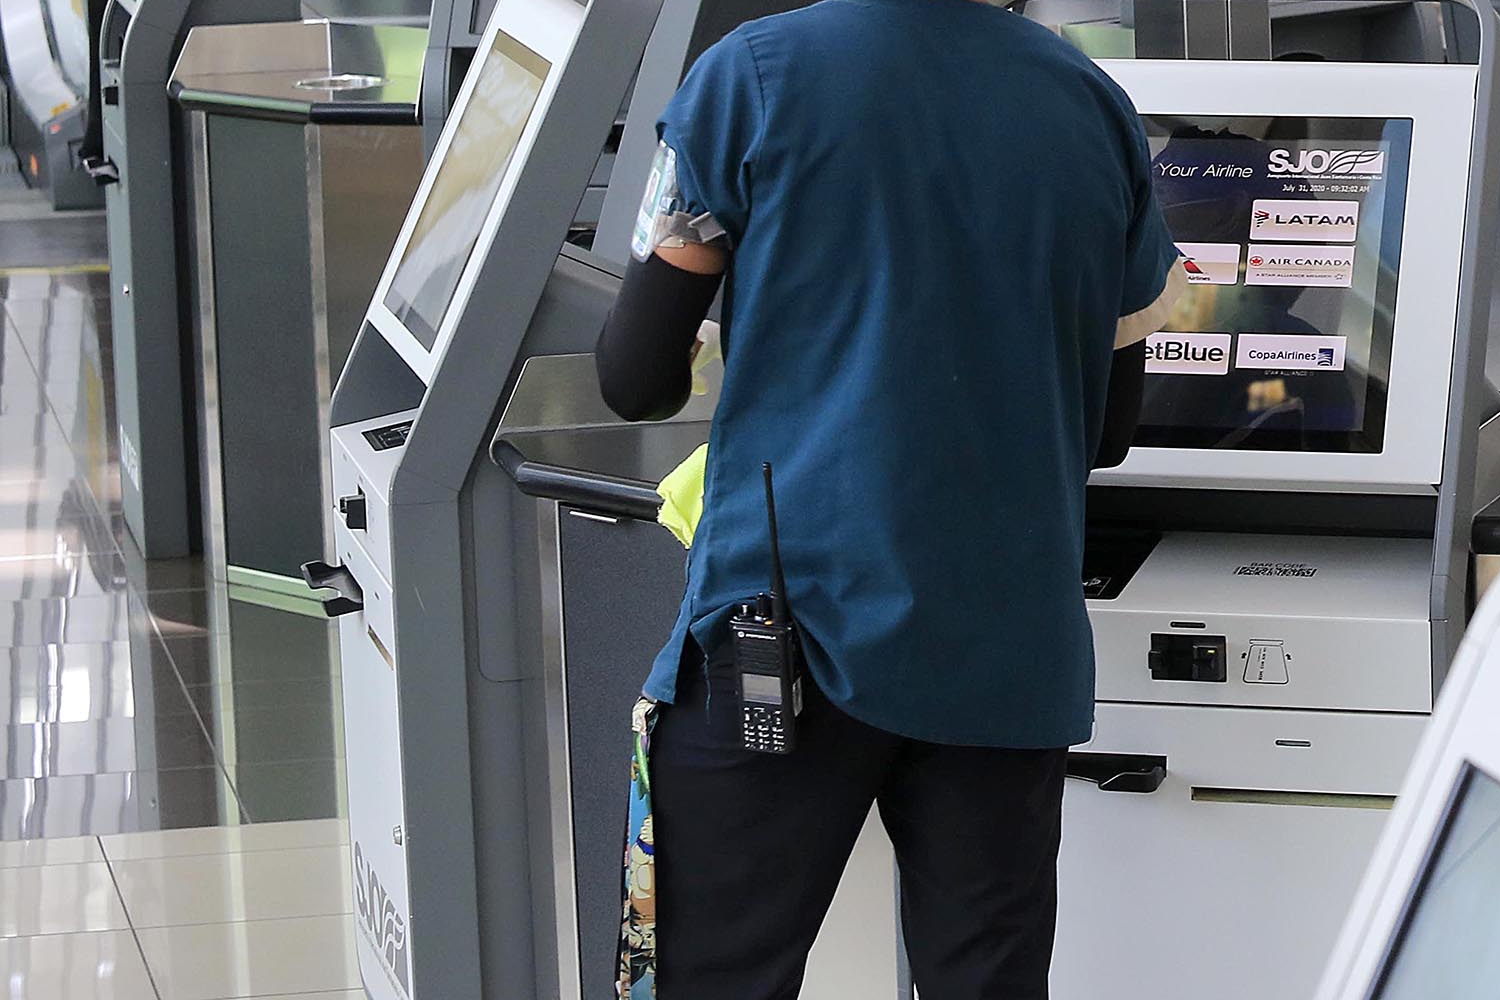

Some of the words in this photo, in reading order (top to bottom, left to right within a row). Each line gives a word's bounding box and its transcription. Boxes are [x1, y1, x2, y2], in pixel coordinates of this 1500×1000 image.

[1268, 149, 1329, 174] SJO
[1159, 162, 1199, 177] Your
[1202, 163, 1254, 178] Airline
[1275, 214, 1355, 226] LATAM
[1268, 258, 1291, 266] AIR
[1294, 258, 1351, 266] CANADA
[1145, 341, 1224, 362] etBlue
